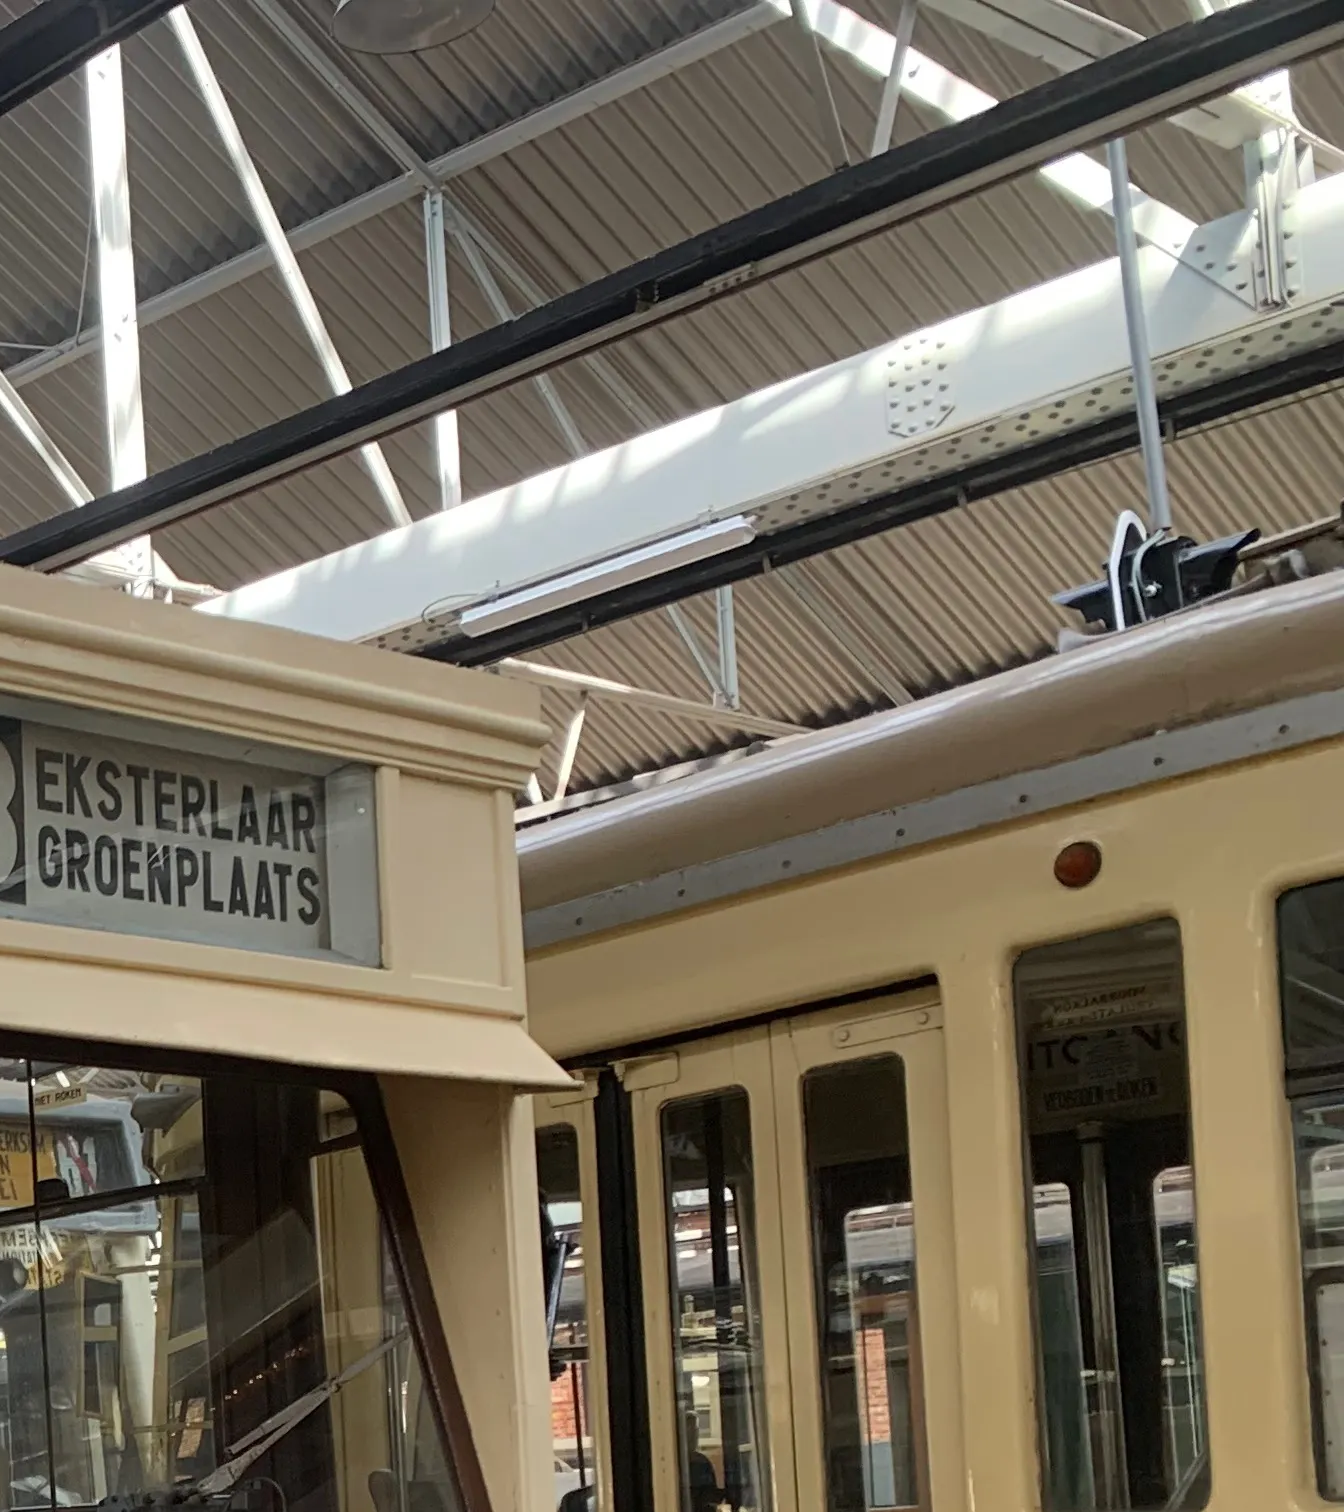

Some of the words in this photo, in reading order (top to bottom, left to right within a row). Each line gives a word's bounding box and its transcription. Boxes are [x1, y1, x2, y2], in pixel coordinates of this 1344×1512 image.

[35, 747, 317, 854] EKSTERLAAR
[37, 825, 321, 926] GROENPLAATS
[55, 1088, 81, 1102] ROKEN
